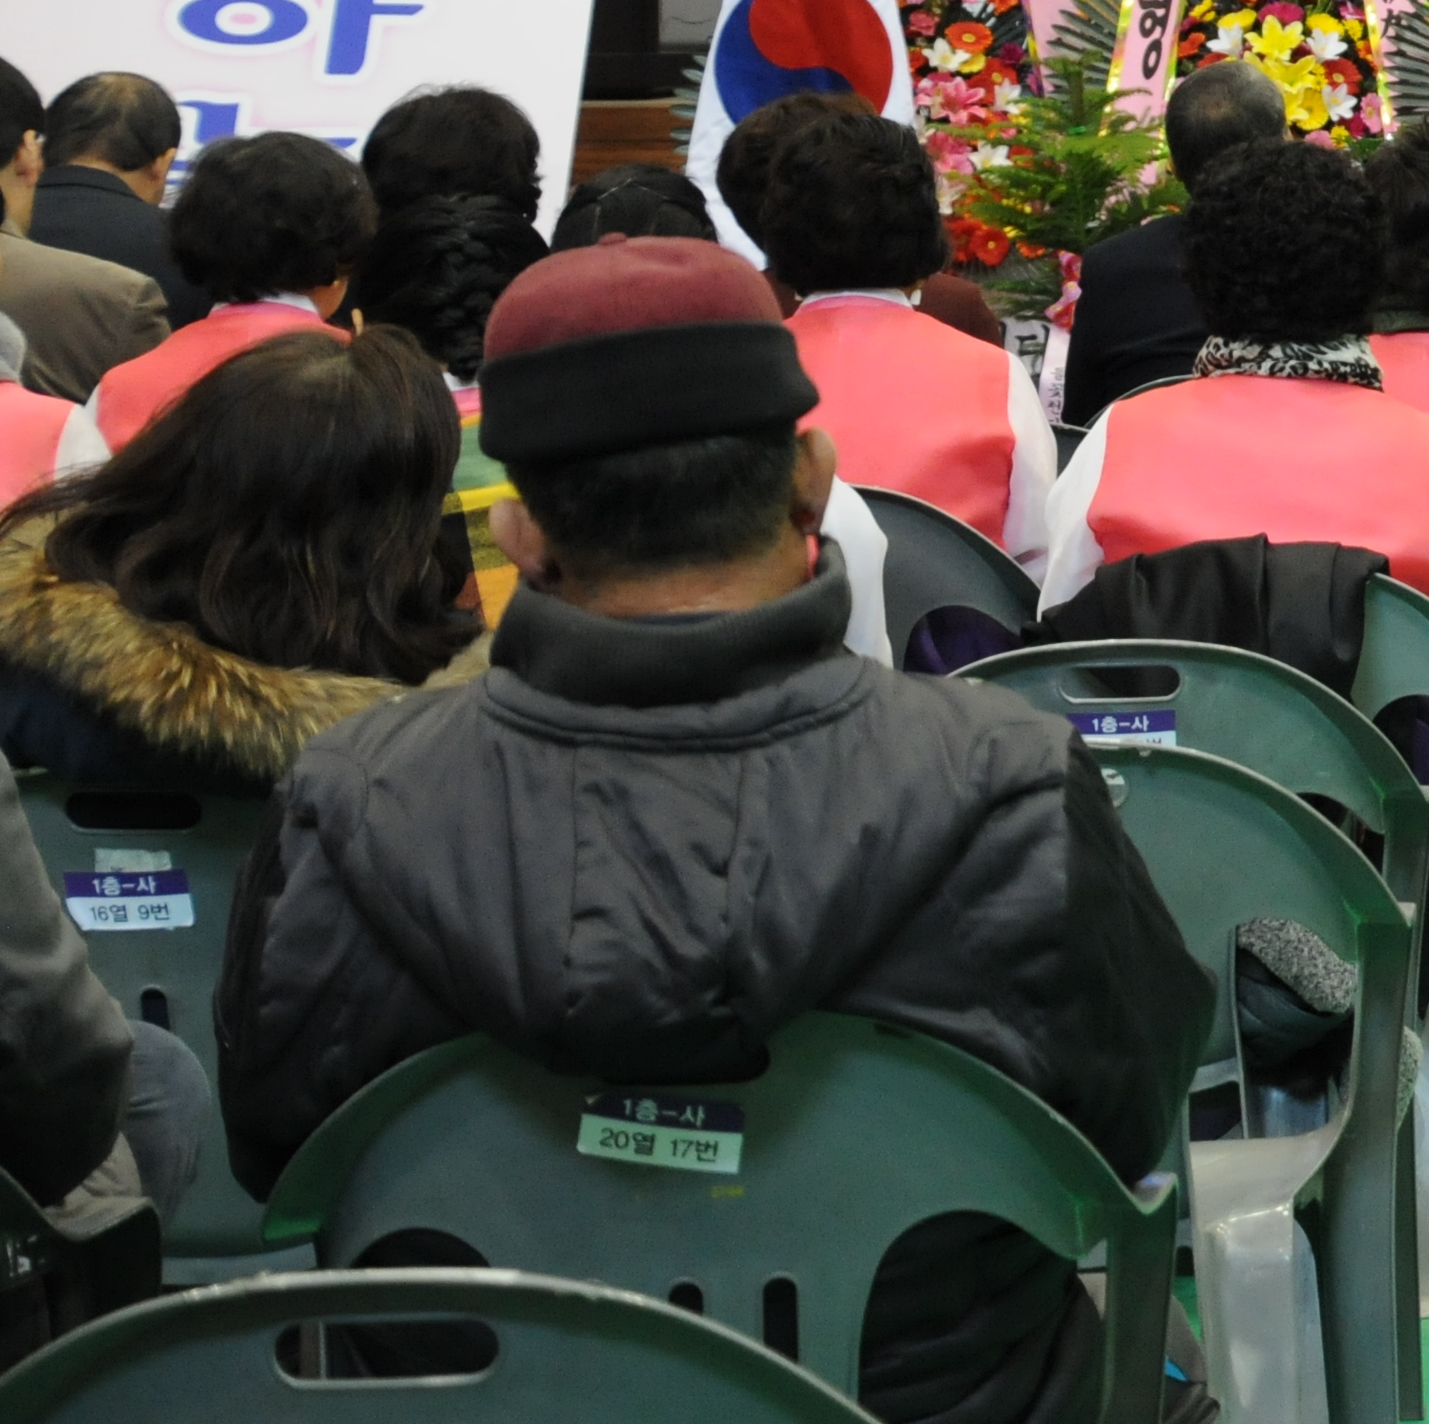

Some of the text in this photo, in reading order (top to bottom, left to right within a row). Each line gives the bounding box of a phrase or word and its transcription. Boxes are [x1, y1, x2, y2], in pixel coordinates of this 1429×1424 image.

[1092, 715, 1150, 734] 1층-사
[92, 875, 156, 896] 1층-사
[89, 902, 171, 923] 16열 9번
[622, 1097, 707, 1127] 1층-사
[598, 1127, 719, 1163] 20열 17번
